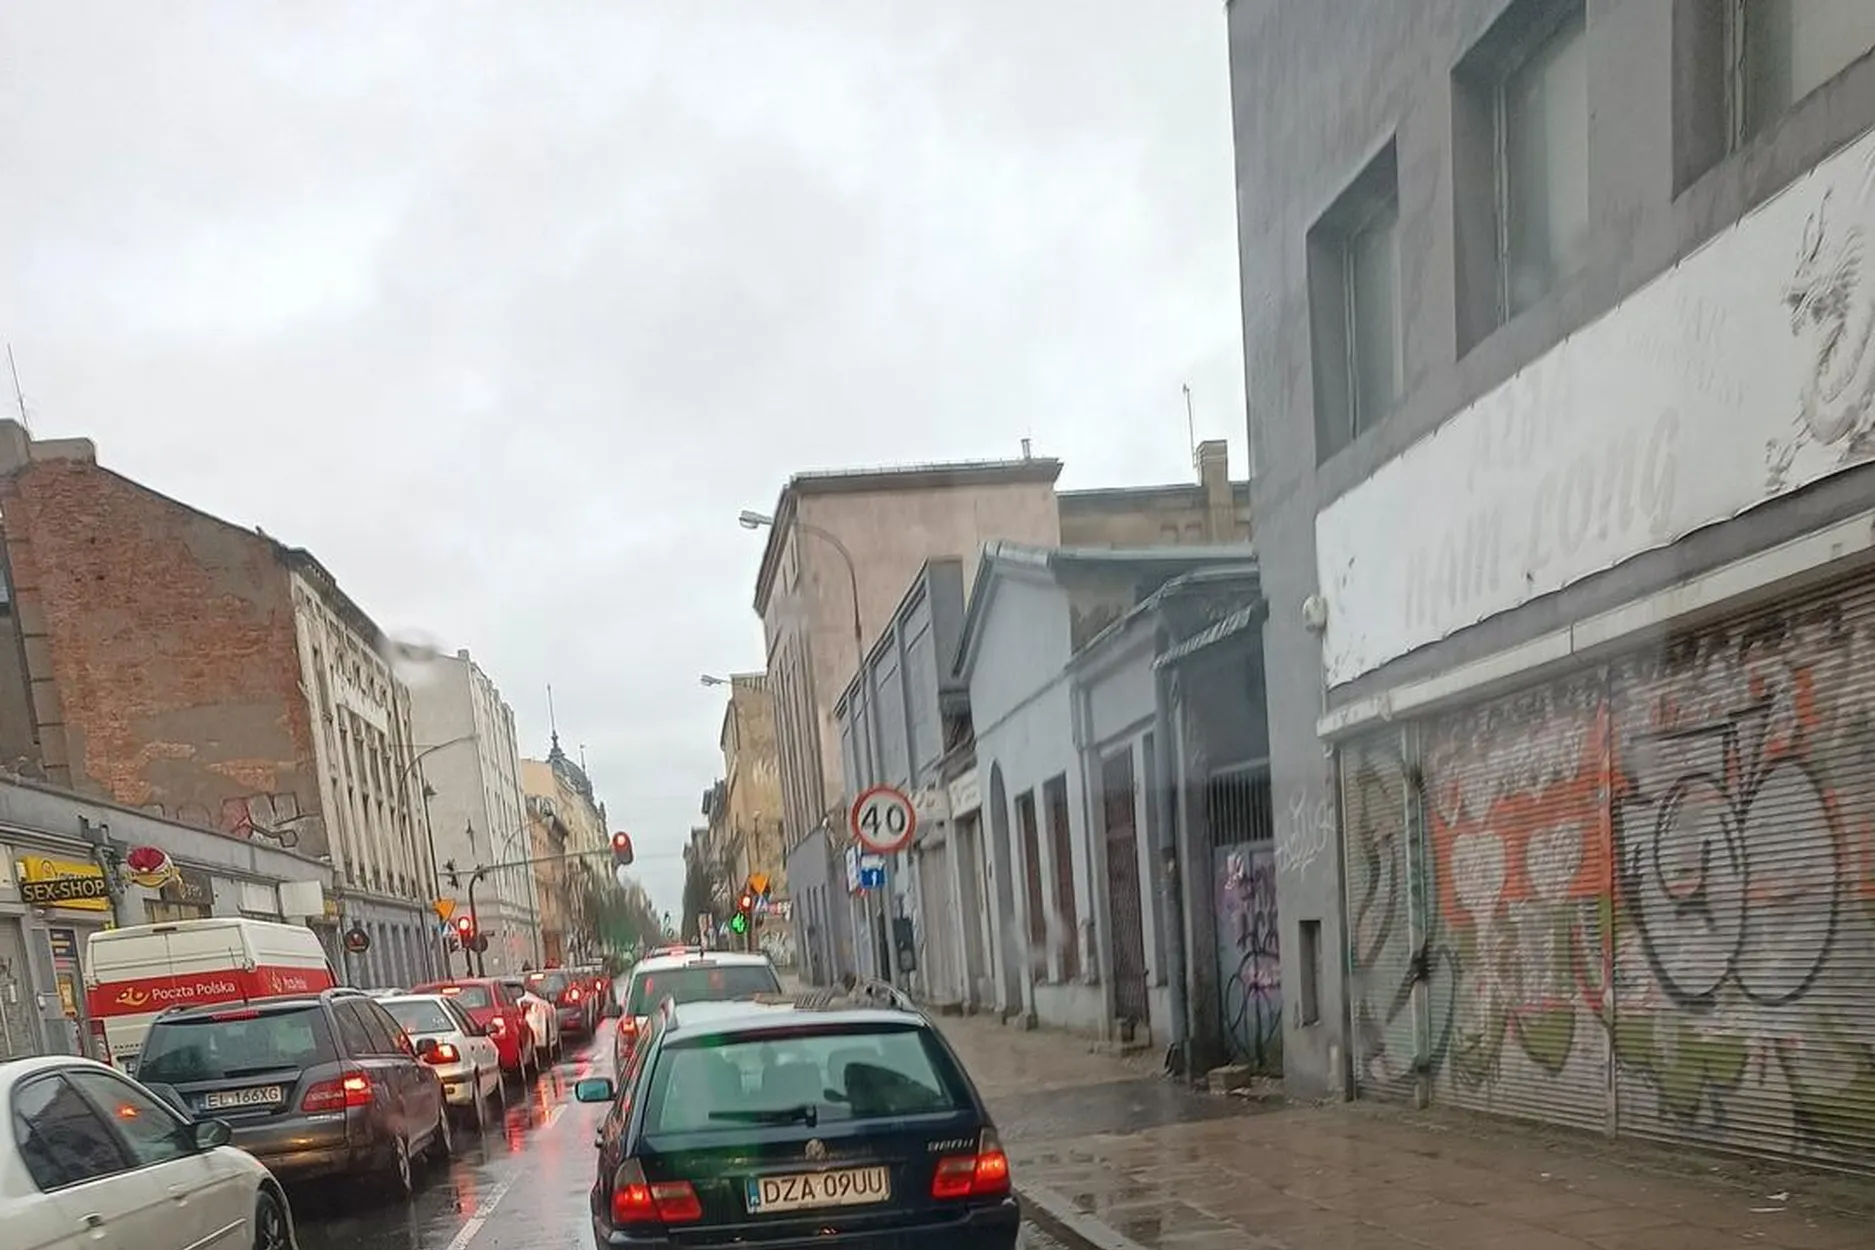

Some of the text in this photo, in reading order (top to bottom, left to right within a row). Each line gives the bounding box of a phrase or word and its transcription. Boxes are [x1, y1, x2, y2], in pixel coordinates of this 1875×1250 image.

[861, 803, 906, 837] 40
[23, 879, 105, 902] SEX-SHOP
[152, 980, 235, 1000] Poczta Polska
[763, 1169, 882, 1204] DZA 09UU
